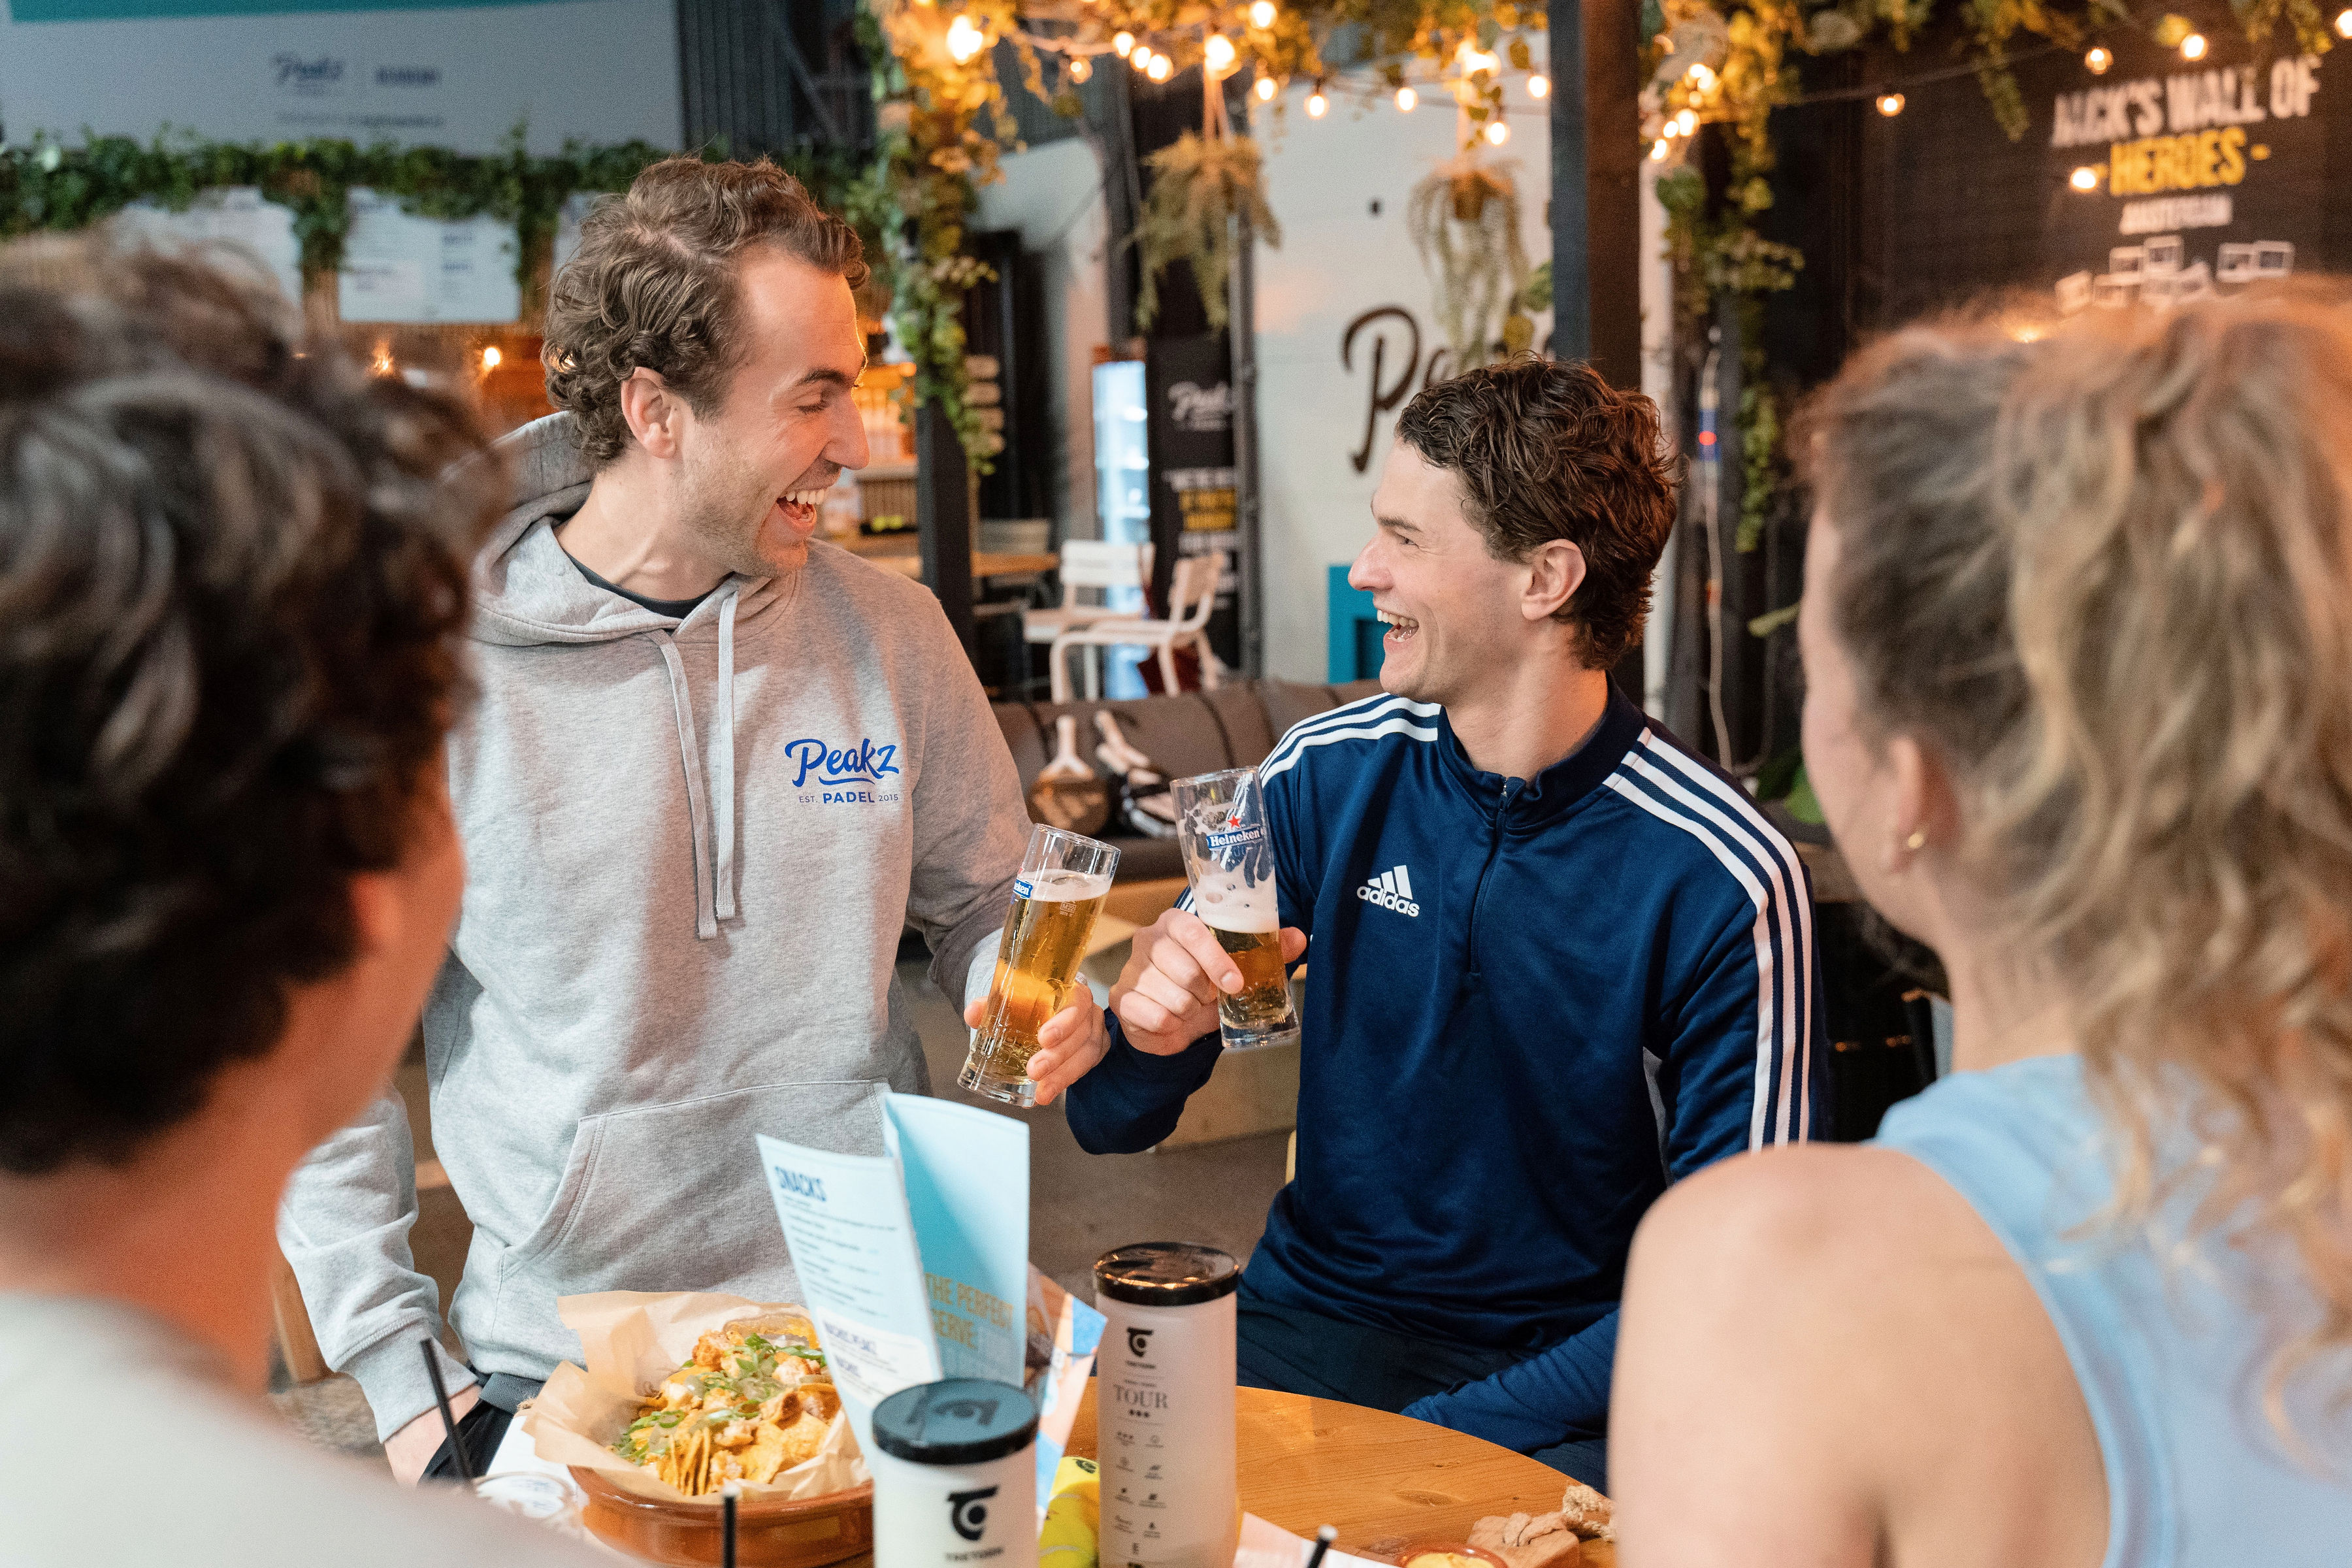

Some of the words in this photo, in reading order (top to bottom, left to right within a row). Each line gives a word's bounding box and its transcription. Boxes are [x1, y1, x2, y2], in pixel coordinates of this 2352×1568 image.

[2270, 54, 2323, 118] OF
[2109, 127, 2247, 195] HEROES
[785, 738, 899, 787] Peakz
[823, 791, 875, 804] PADEL
[1209, 829, 1260, 847] Heineken
[1356, 885, 1420, 917] adidas
[775, 1166, 826, 1202] SNACKS
[924, 1272, 953, 1305] THE
[956, 1282, 1014, 1332] PERFECT
[1113, 1383, 1168, 1409] TOUR
